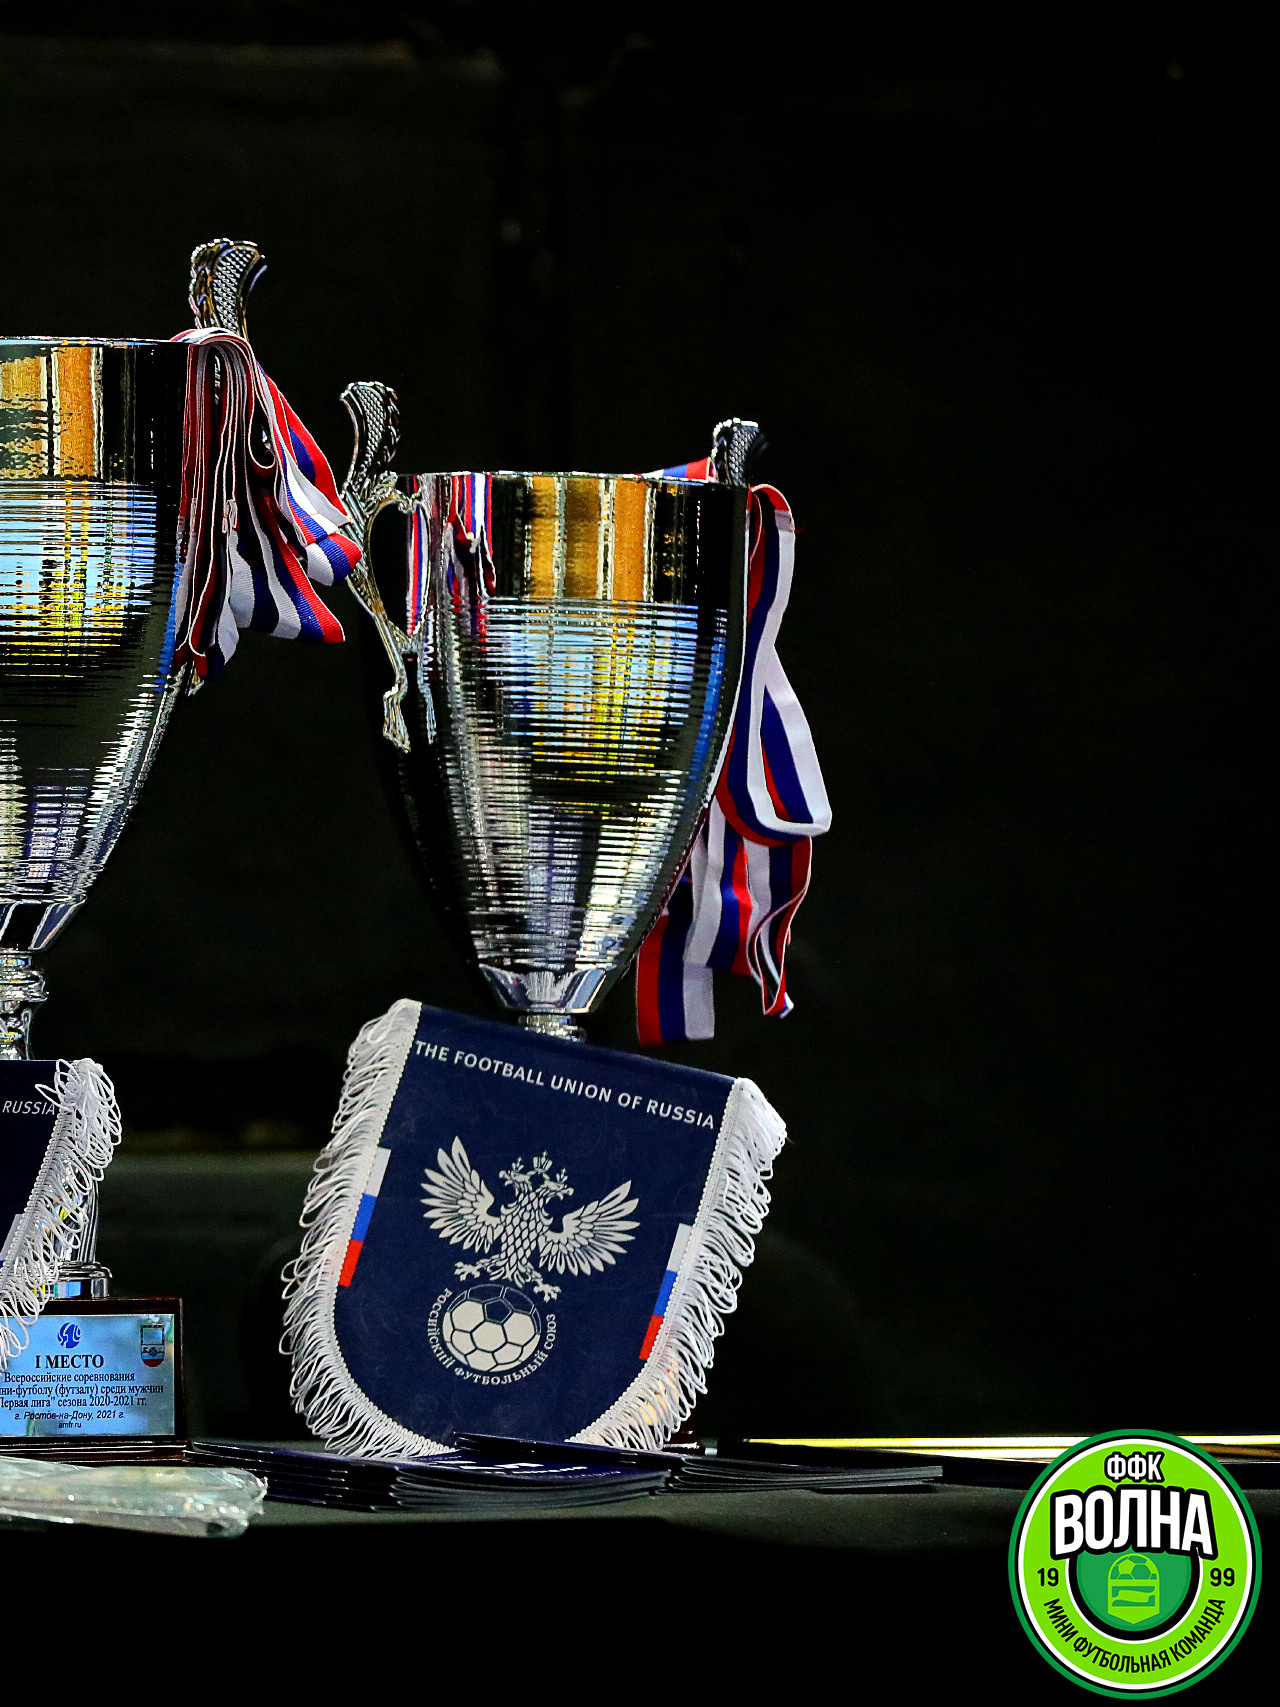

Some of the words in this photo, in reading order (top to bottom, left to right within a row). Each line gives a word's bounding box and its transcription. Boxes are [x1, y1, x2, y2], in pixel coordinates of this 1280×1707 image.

[415, 1040, 449, 1062] THE
[454, 1051, 544, 1086] FOOTBALL
[550, 1075, 612, 1102] UNION
[618, 1093, 642, 1109] OF
[646, 1099, 715, 1130] RUSSIA
[2, 1101, 55, 1115] RUSSIA
[428, 1288, 453, 1368] РОССИЙСКИЙ
[455, 1350, 548, 1385] ФУТБОЛЬНЫЙ
[544, 1314, 556, 1349] СОЮЗ
[45, 1354, 104, 1368] МЕСТО
[4, 1373, 71, 1384] Всероссийские
[74, 1373, 135, 1384] соревнования
[55, 1384, 98, 1396] (футзалу)
[101, 1385, 126, 1396] среди
[128, 1384, 163, 1394] мужчин
[58, 1398, 87, 1407] сезона
[90, 1396, 134, 1406] 2020-2021
[24, 1411, 94, 1420] Ростов-на-Дону,
[97, 1411, 115, 1419] 2021
